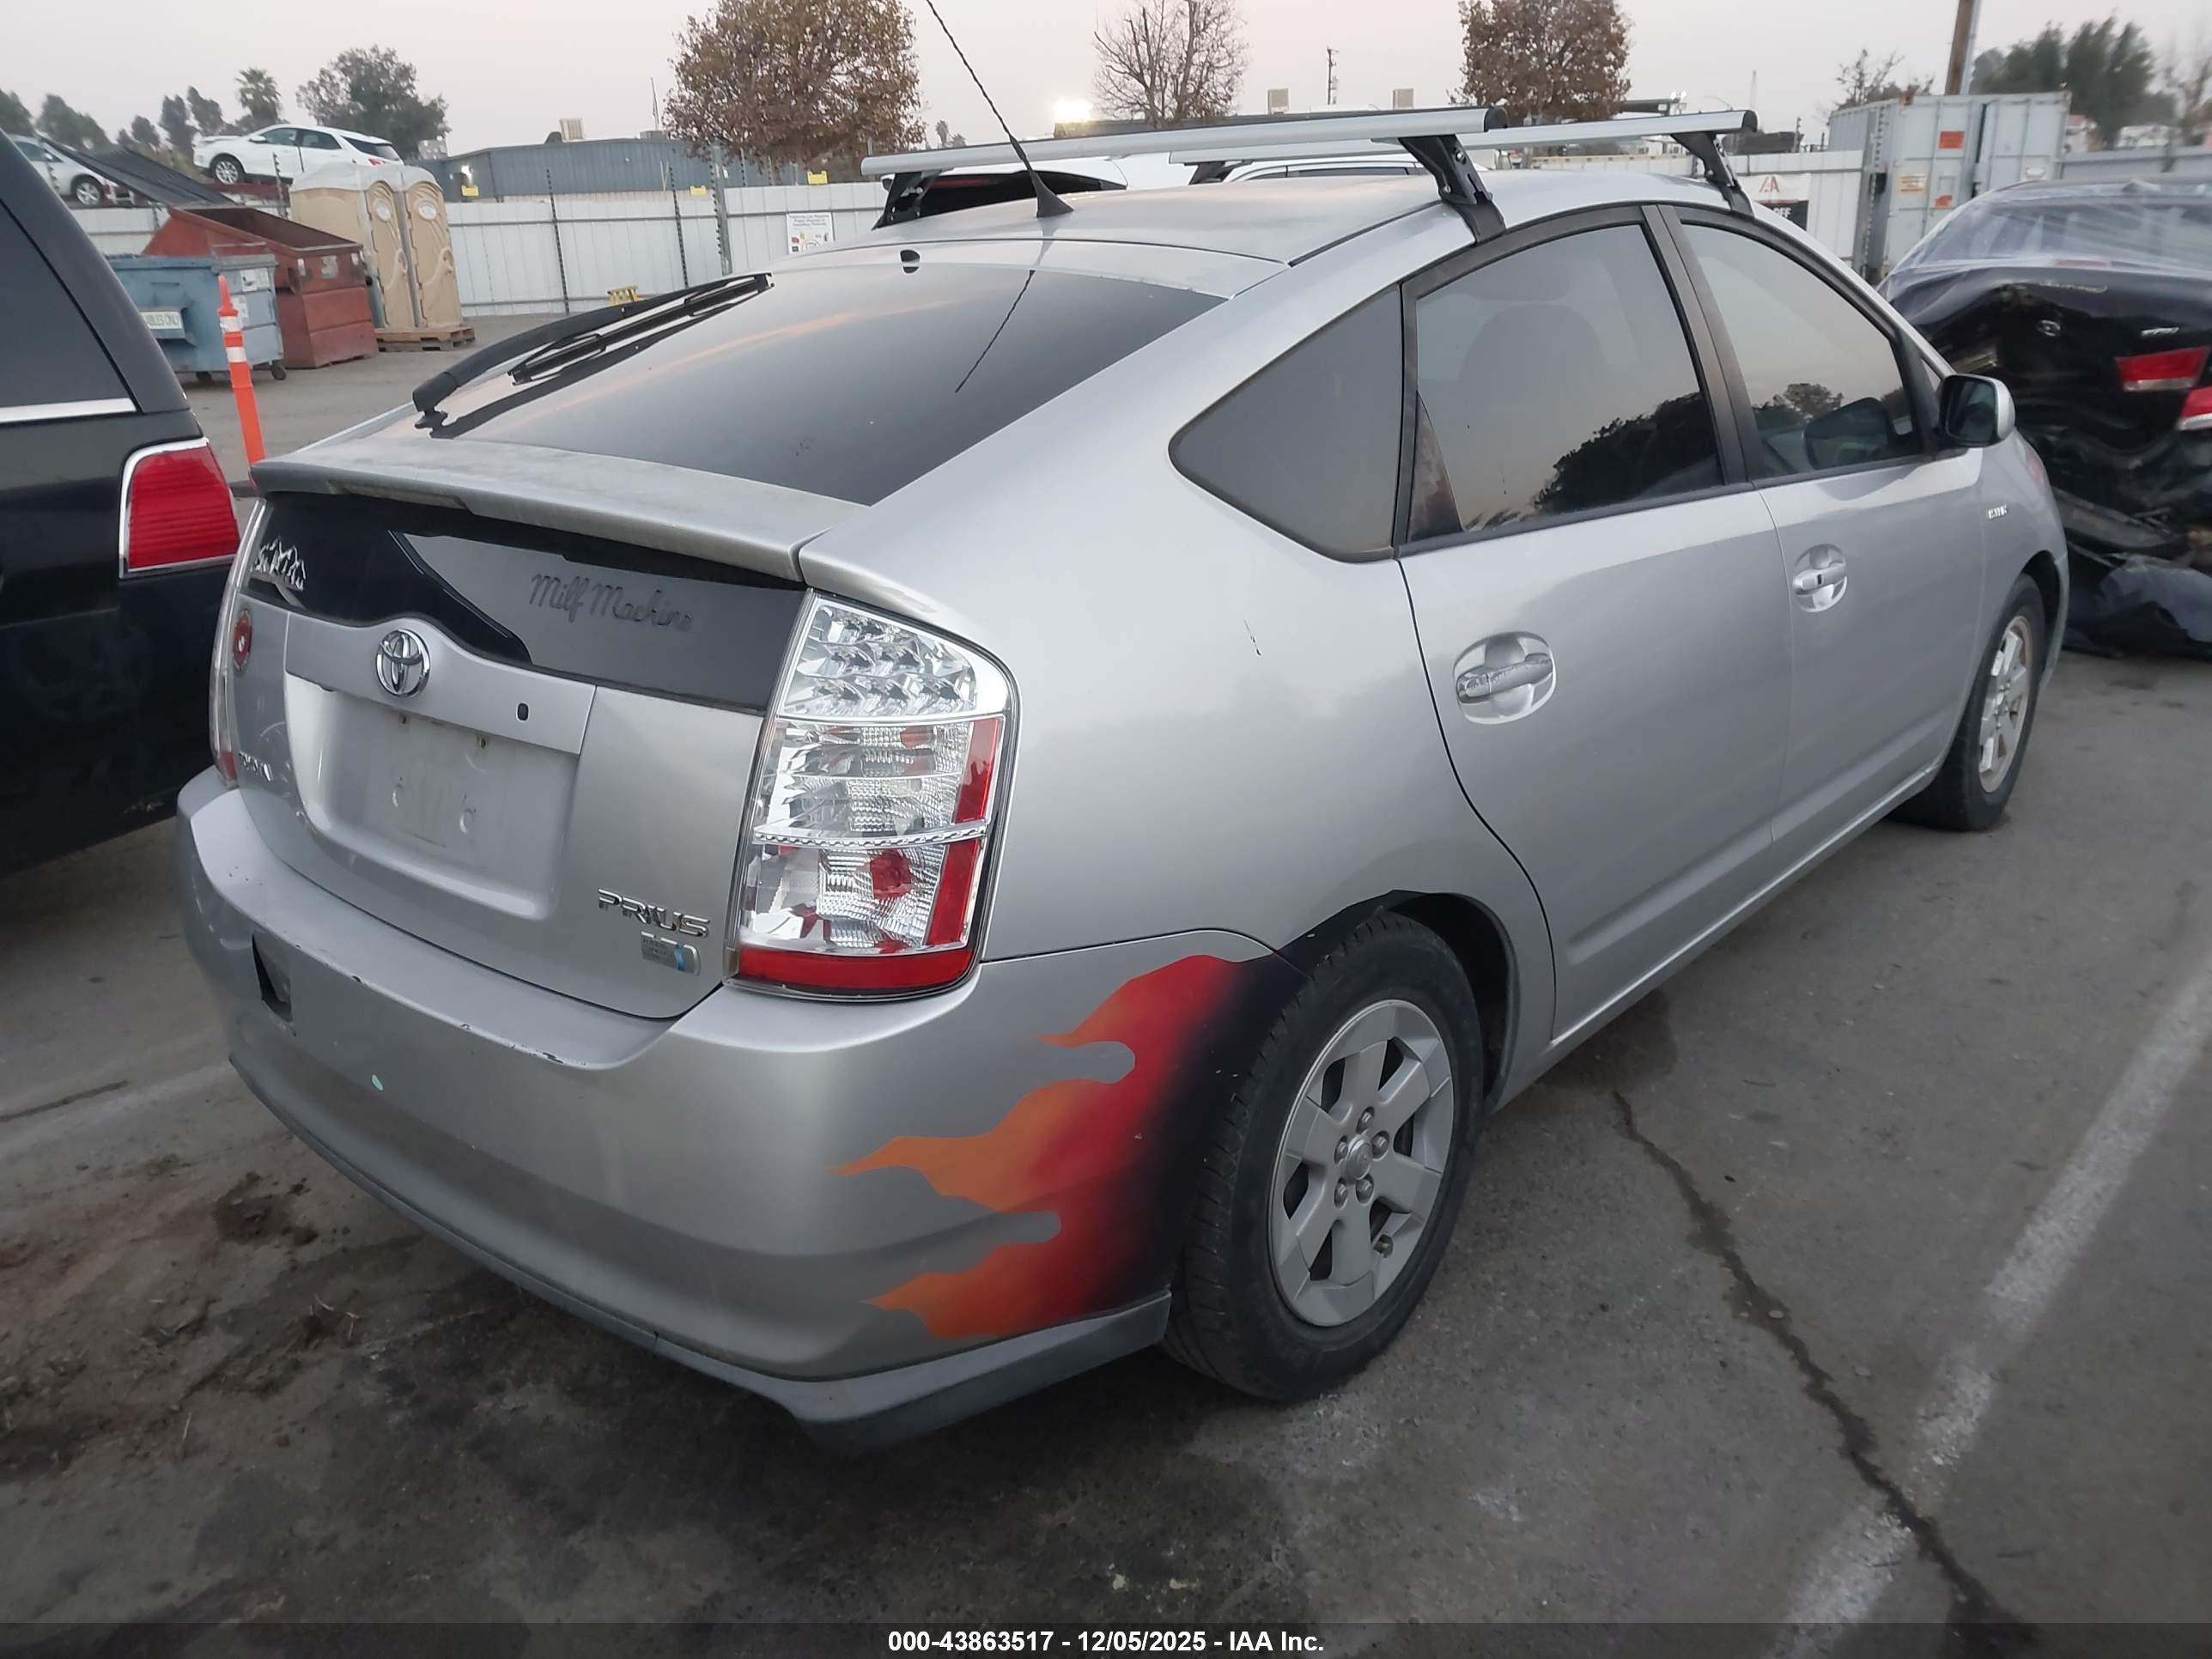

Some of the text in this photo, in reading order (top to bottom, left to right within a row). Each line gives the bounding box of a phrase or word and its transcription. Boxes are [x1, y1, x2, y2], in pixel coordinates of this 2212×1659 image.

[530, 573, 693, 633] Milf Machine
[598, 888, 710, 938] PRIUS
